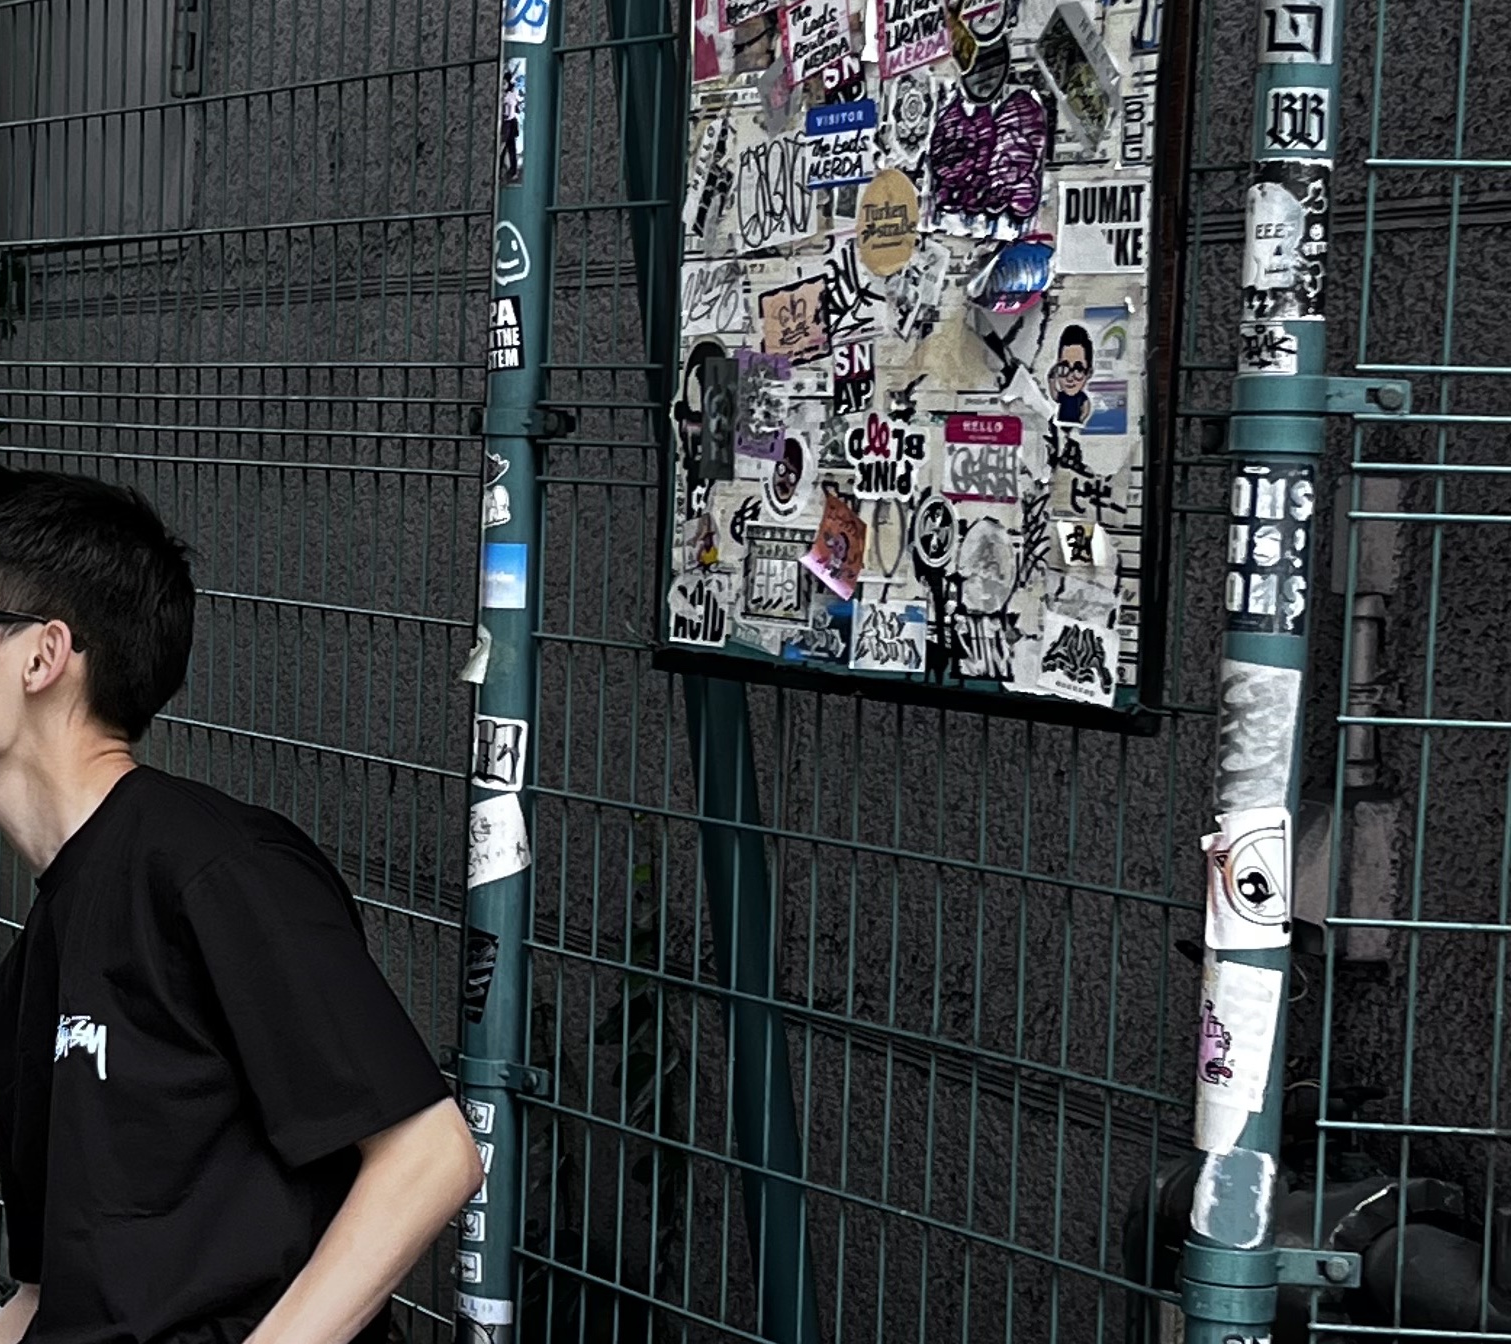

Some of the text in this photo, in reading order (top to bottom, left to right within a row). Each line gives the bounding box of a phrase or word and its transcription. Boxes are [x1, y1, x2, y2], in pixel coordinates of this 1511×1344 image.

[889, 29, 946, 70] MERDA
[816, 110, 863, 126] VISITOR
[808, 155, 863, 181] MERDA
[1065, 184, 1145, 225] DUMAT
[963, 420, 1003, 433] HELLO
[857, 460, 913, 494] PINK
